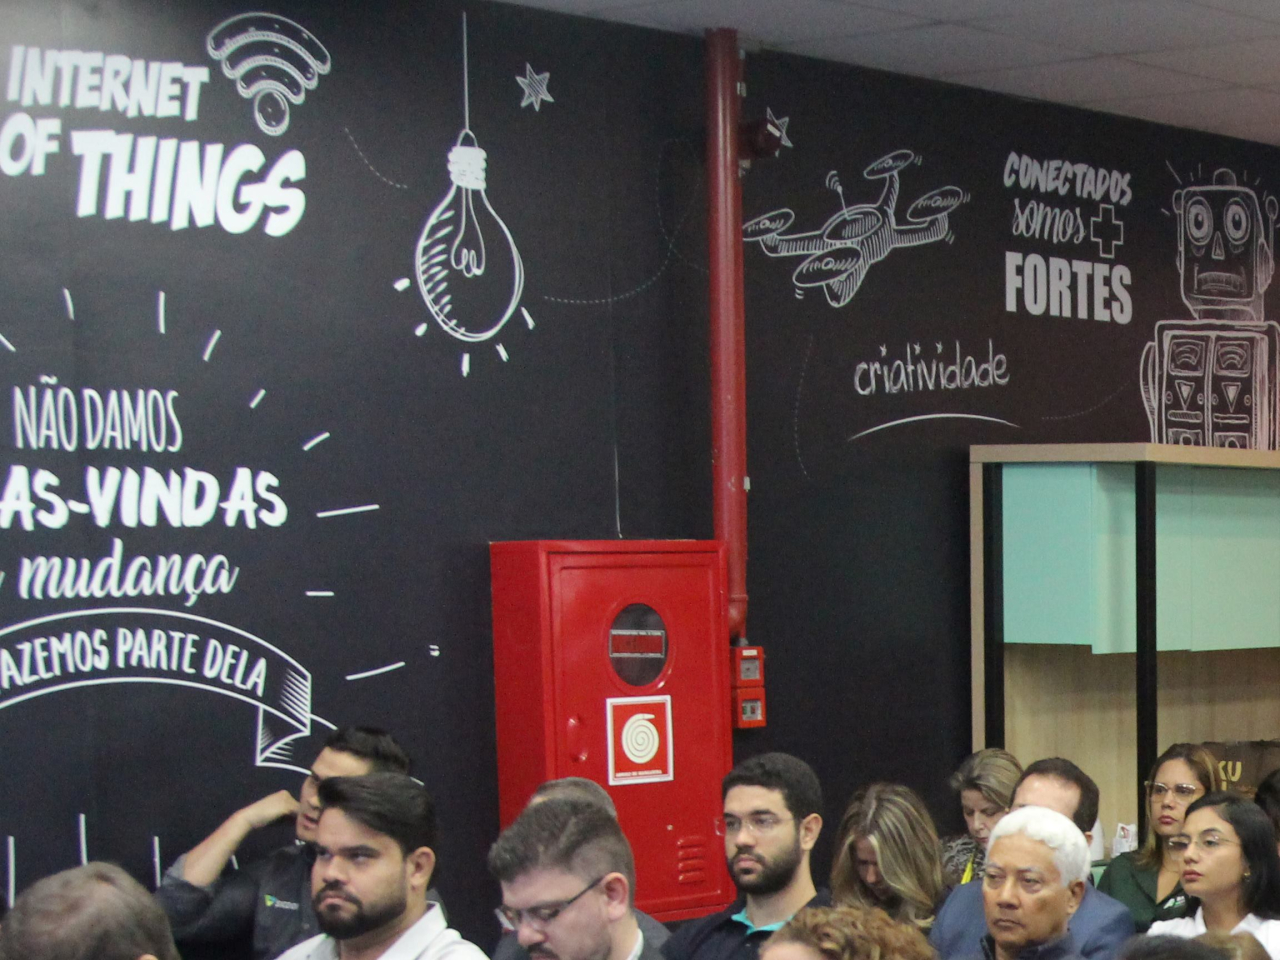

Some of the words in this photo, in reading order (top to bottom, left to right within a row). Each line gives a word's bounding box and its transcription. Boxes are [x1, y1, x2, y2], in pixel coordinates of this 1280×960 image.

[7, 45, 209, 121] INTERNET
[0, 112, 61, 176] OF
[70, 129, 306, 237] THINGS
[1003, 151, 1132, 206] CONECTADOS
[1012, 198, 1086, 244] somos
[1005, 251, 1133, 325] FORTES
[854, 338, 1010, 396] criatividade
[13, 374, 78, 452] NÃO
[81, 387, 183, 453] DAMOS
[18, 537, 240, 607] mudança
[115, 627, 200, 674] PARTE
[202, 638, 268, 698] DELA
